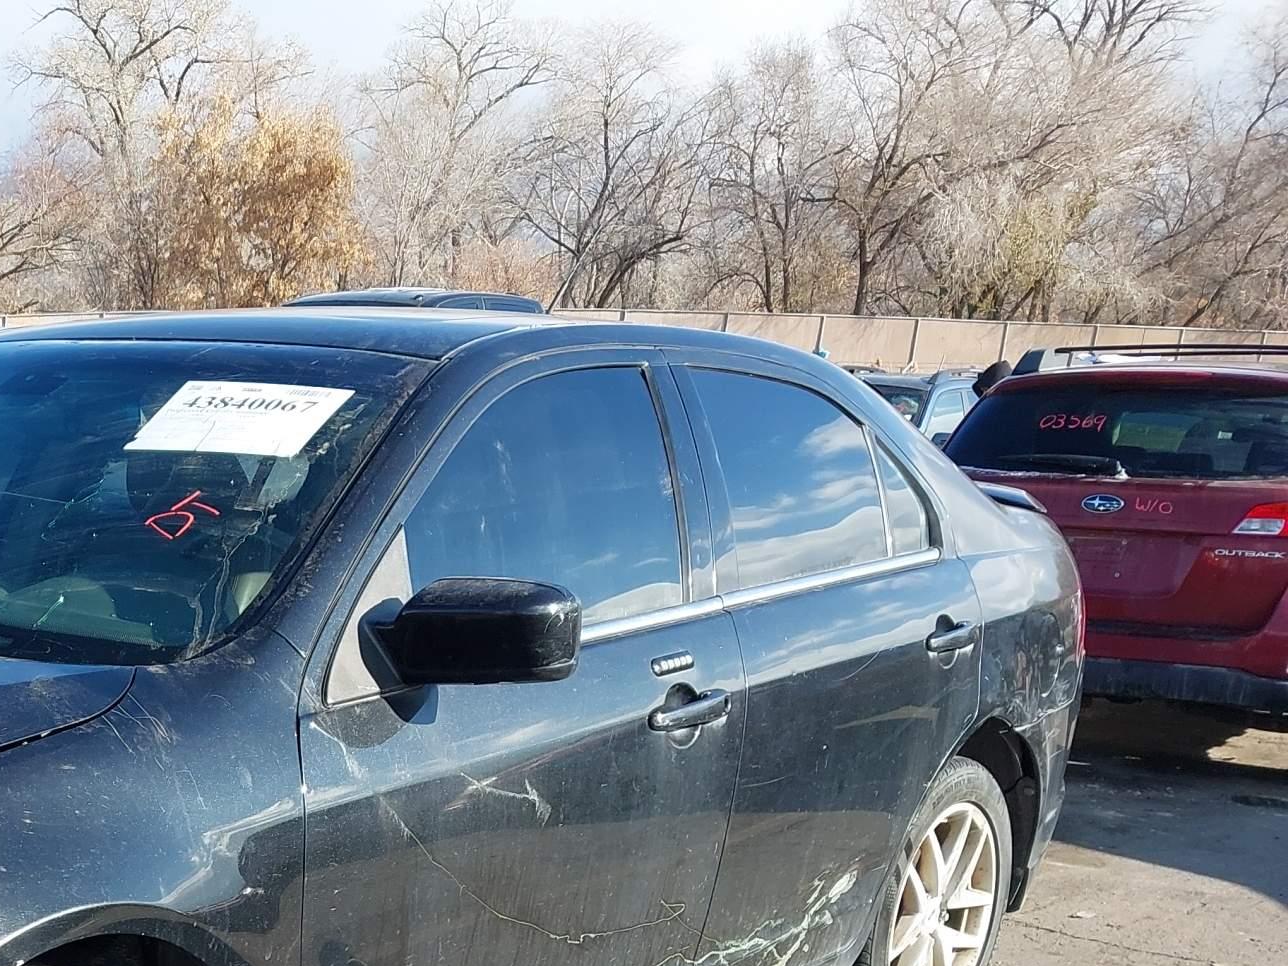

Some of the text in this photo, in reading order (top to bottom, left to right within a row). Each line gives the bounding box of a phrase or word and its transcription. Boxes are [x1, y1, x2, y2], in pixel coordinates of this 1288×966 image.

[182, 395, 320, 413] 43840067
[1039, 414, 1107, 433] 03569
[1214, 548, 1287, 559] OUTBACK
